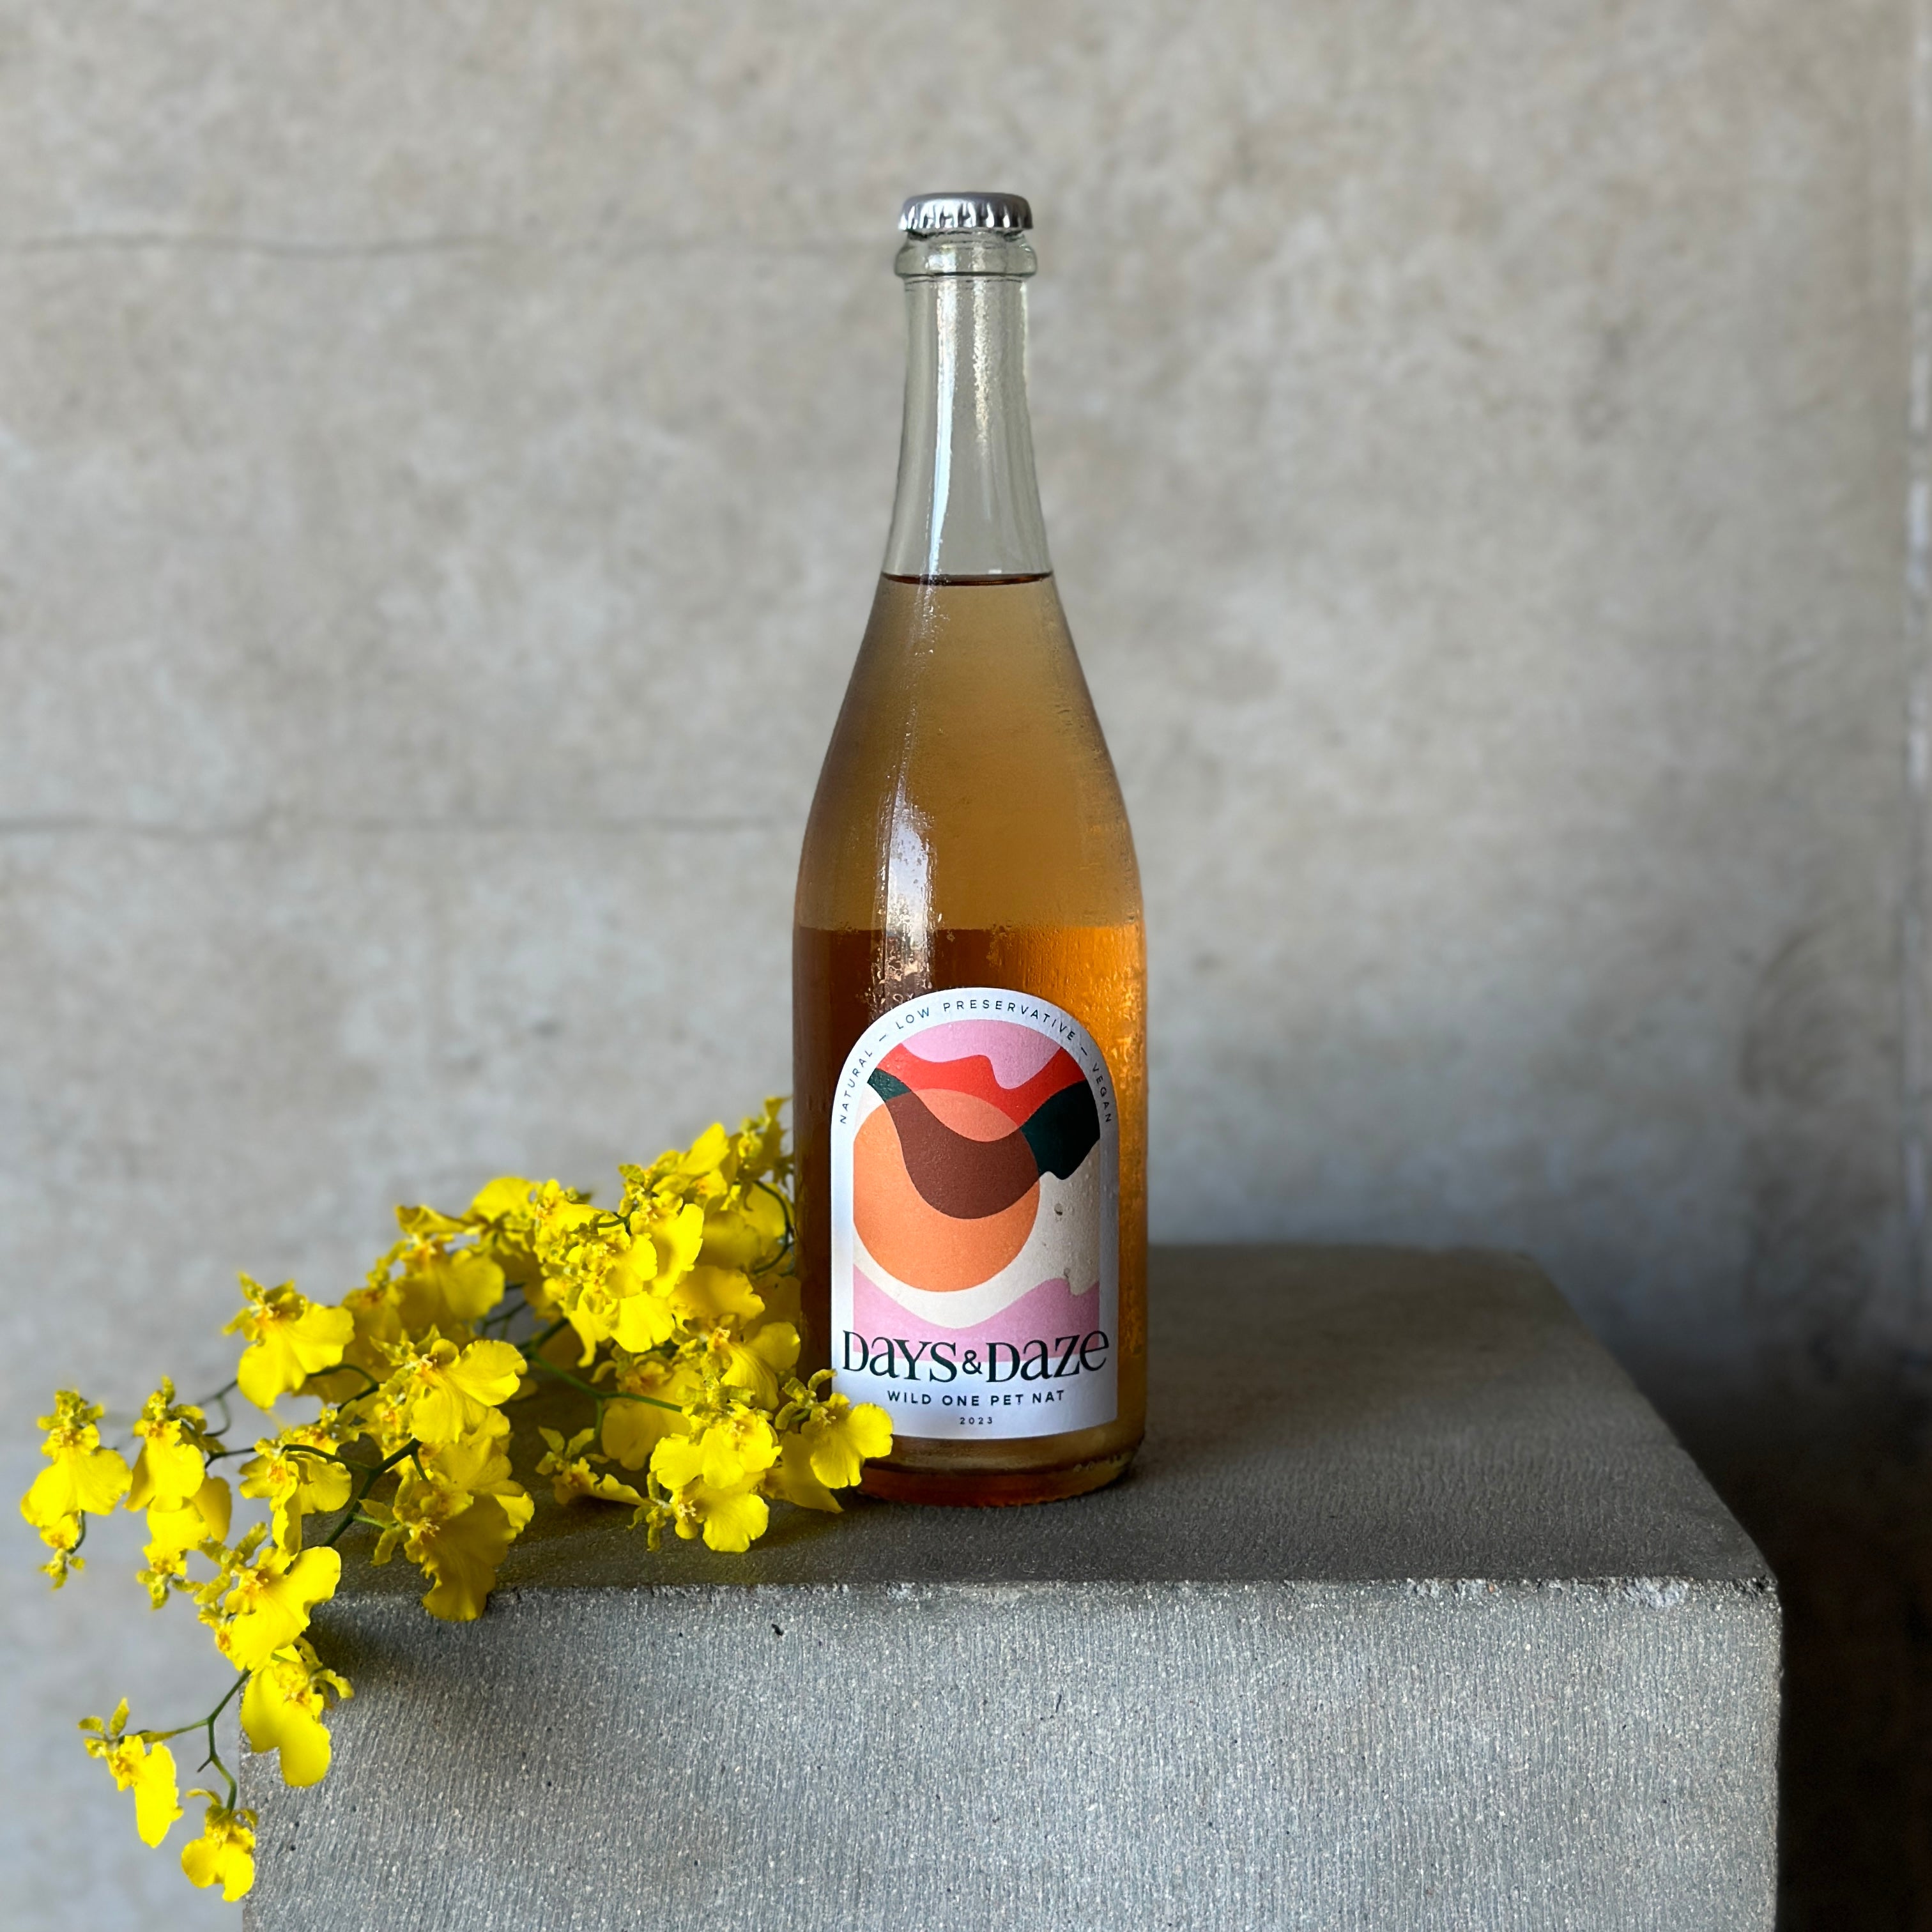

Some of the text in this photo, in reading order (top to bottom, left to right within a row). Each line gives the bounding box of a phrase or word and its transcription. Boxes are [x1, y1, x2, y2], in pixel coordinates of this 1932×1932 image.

[839, 1000, 1112, 1124] NATURAL LOW PRESERVATIVE VEGAN
[887, 1390, 1064, 1406] WILD ONE PET NAT
[959, 1416, 993, 1425] 2023
